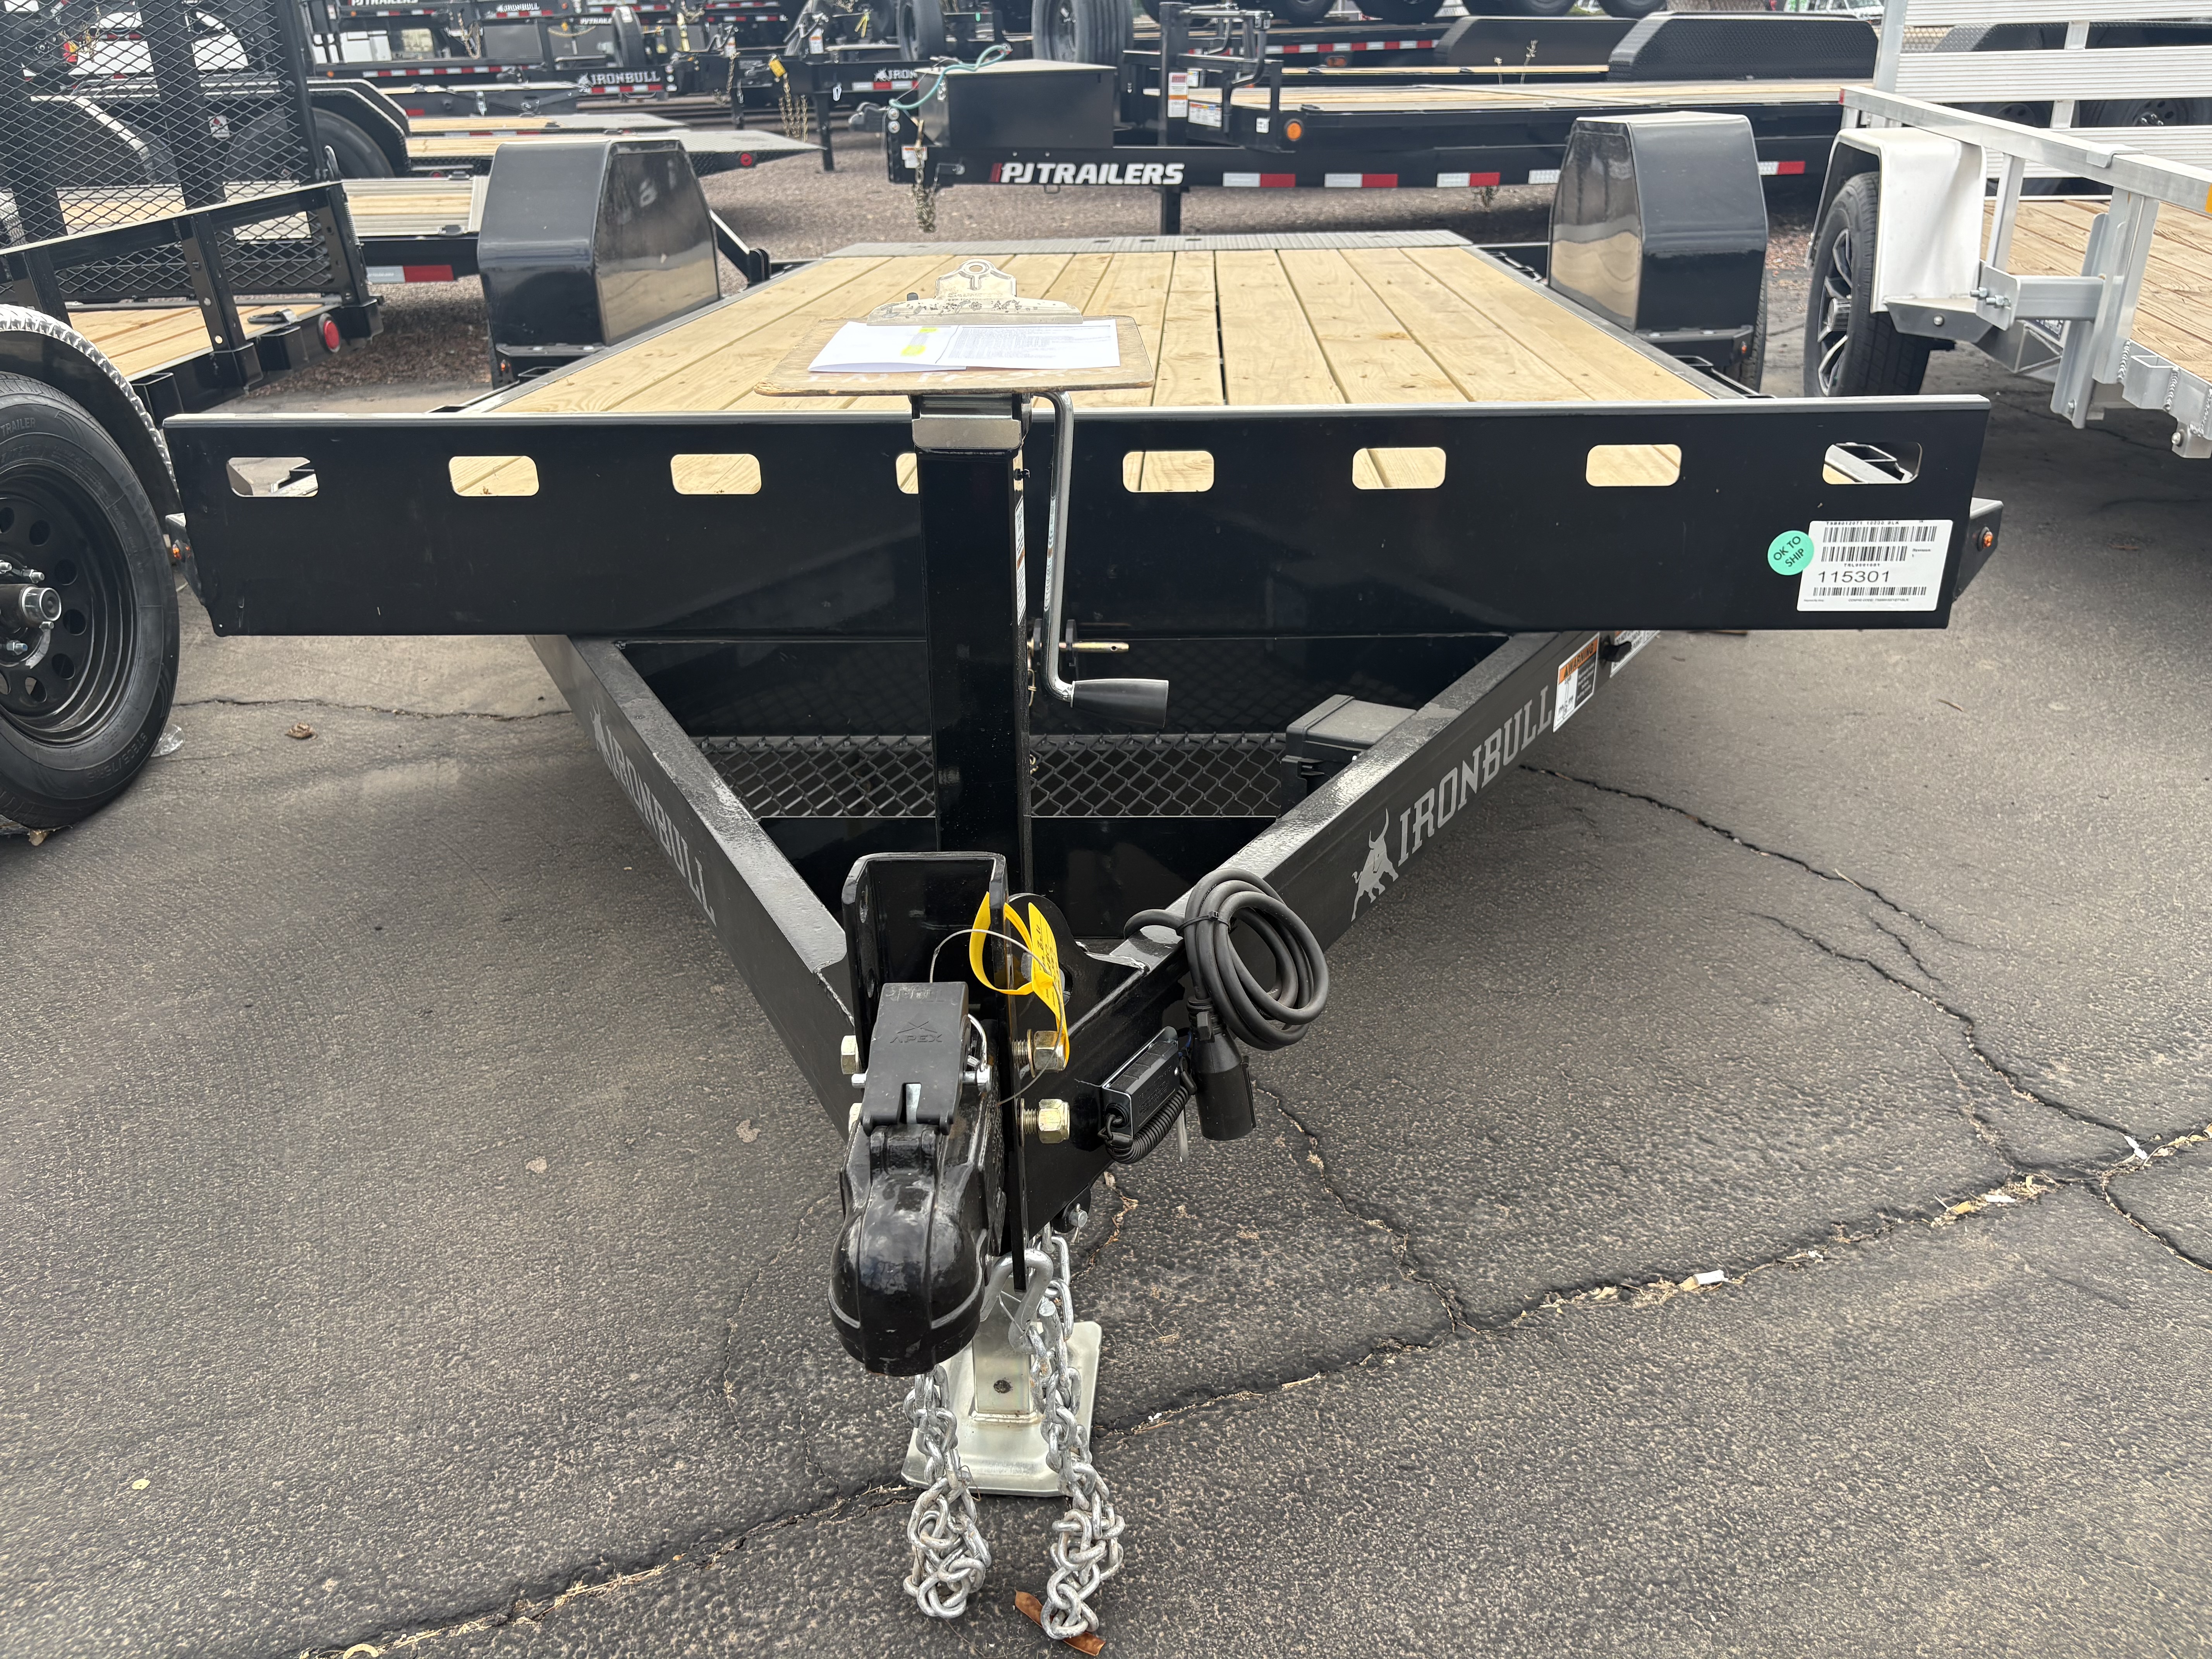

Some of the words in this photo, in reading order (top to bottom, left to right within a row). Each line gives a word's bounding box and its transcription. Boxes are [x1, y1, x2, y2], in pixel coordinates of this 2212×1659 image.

[591, 70, 661, 85] IRONBULL
[888, 69, 918, 79] IRON
[1000, 162, 1035, 184] PJ
[1036, 162, 1185, 185] TRAILERS
[0, 417, 36, 437] TRAILER
[1773, 546, 1789, 560] OK
[1786, 536, 1801, 548] TO
[1785, 548, 1804, 567] SHIP
[1818, 571, 1889, 583] 115301
[1568, 643, 1594, 673] WARNING
[1398, 685, 1553, 867] IRONBULL
[606, 725, 717, 927] IRONBULL
[890, 1034, 943, 1044] APEX
